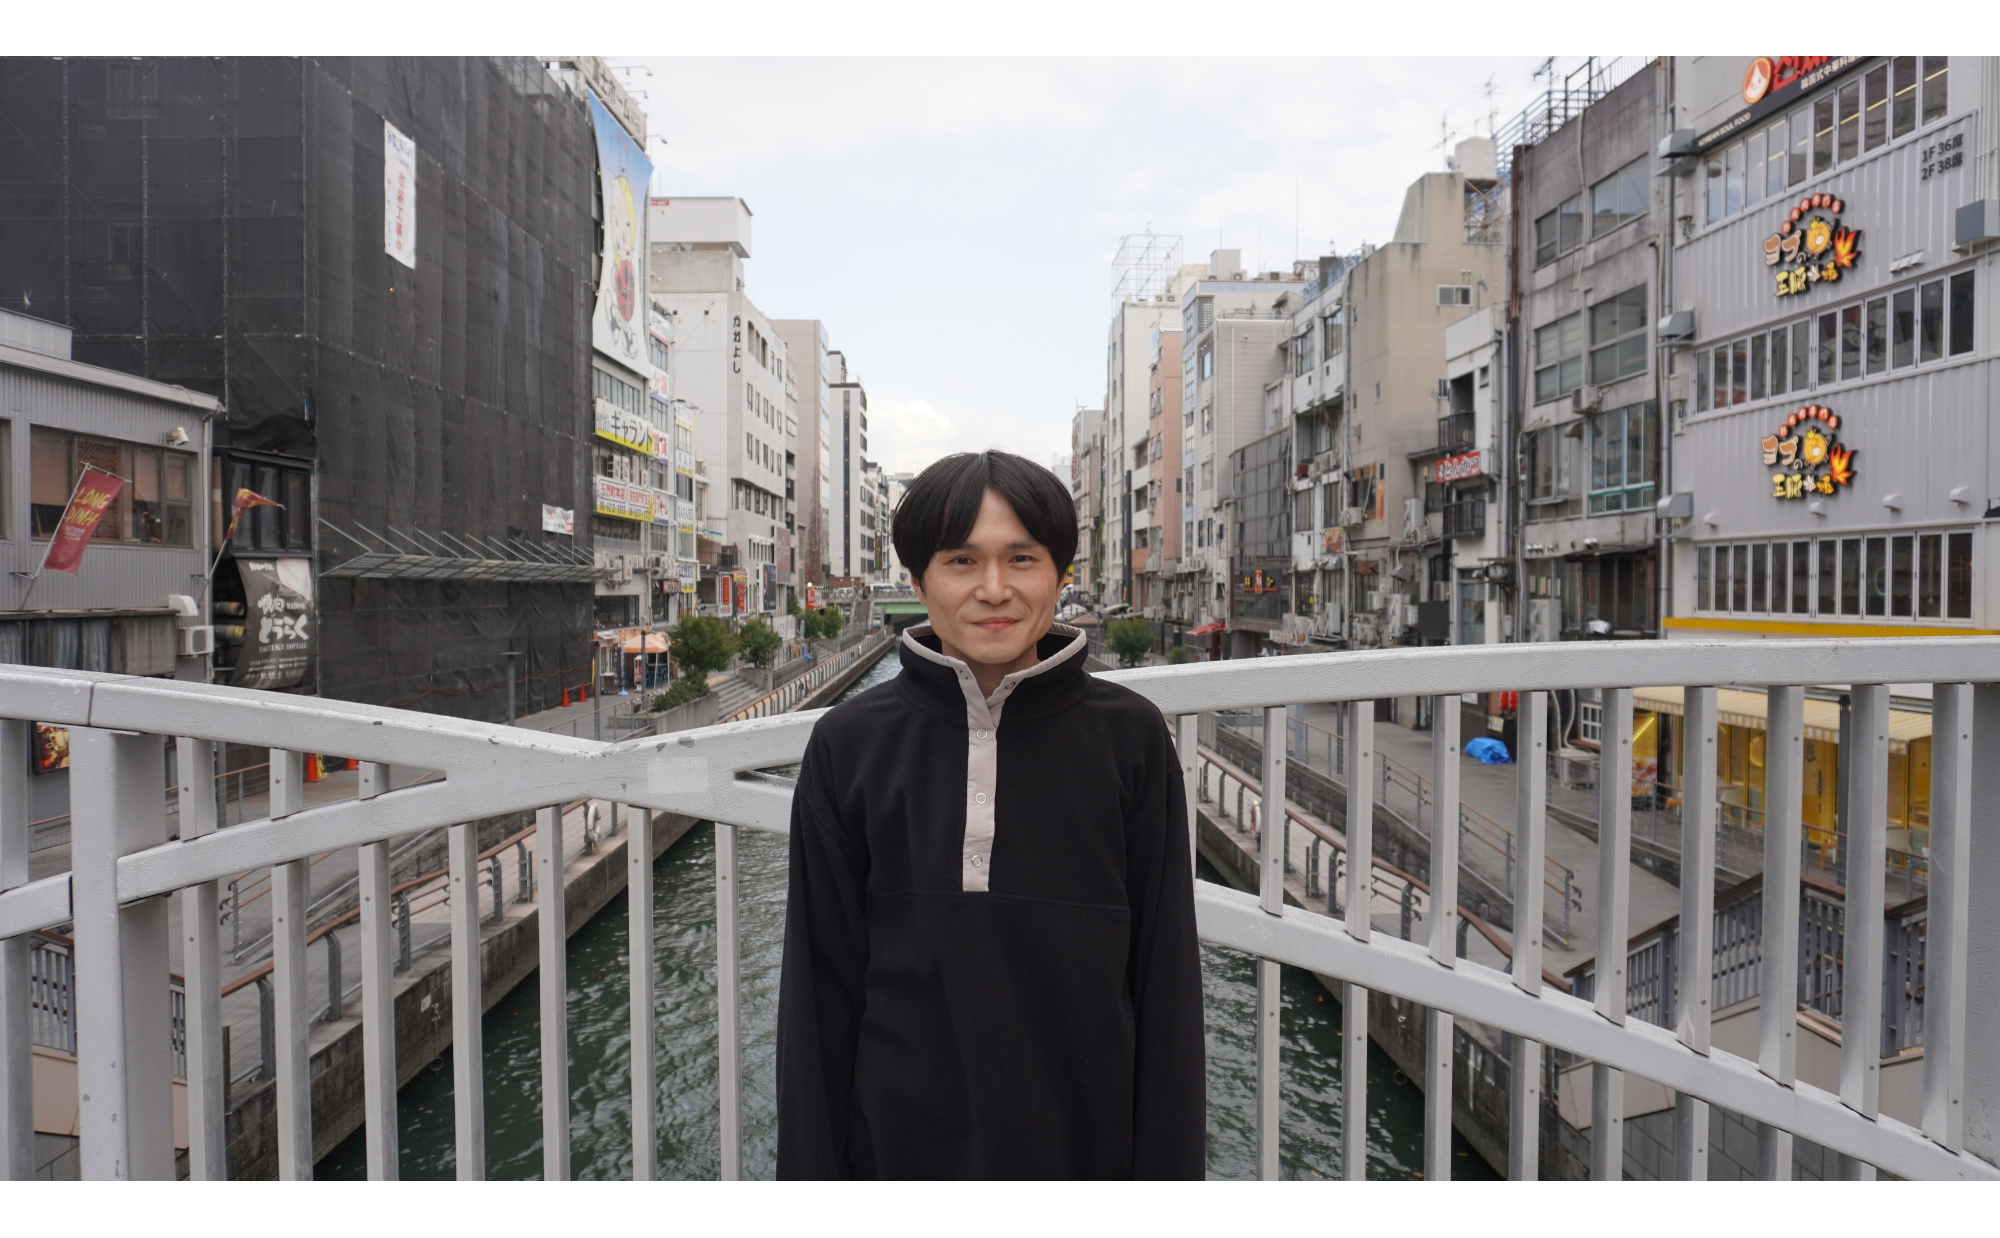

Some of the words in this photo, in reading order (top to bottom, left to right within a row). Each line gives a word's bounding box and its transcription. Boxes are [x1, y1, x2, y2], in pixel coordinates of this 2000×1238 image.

[1734, 112, 1752, 127] FOOD
[1922, 145, 1936, 163] 1F
[1921, 163, 1936, 181] 2F
[611, 410, 652, 452] ギャラント
[1445, 456, 1480, 480] とんかつ
[74, 486, 111, 511] LONG
[65, 505, 100, 527] DINH
[258, 613, 309, 644] どうらく
